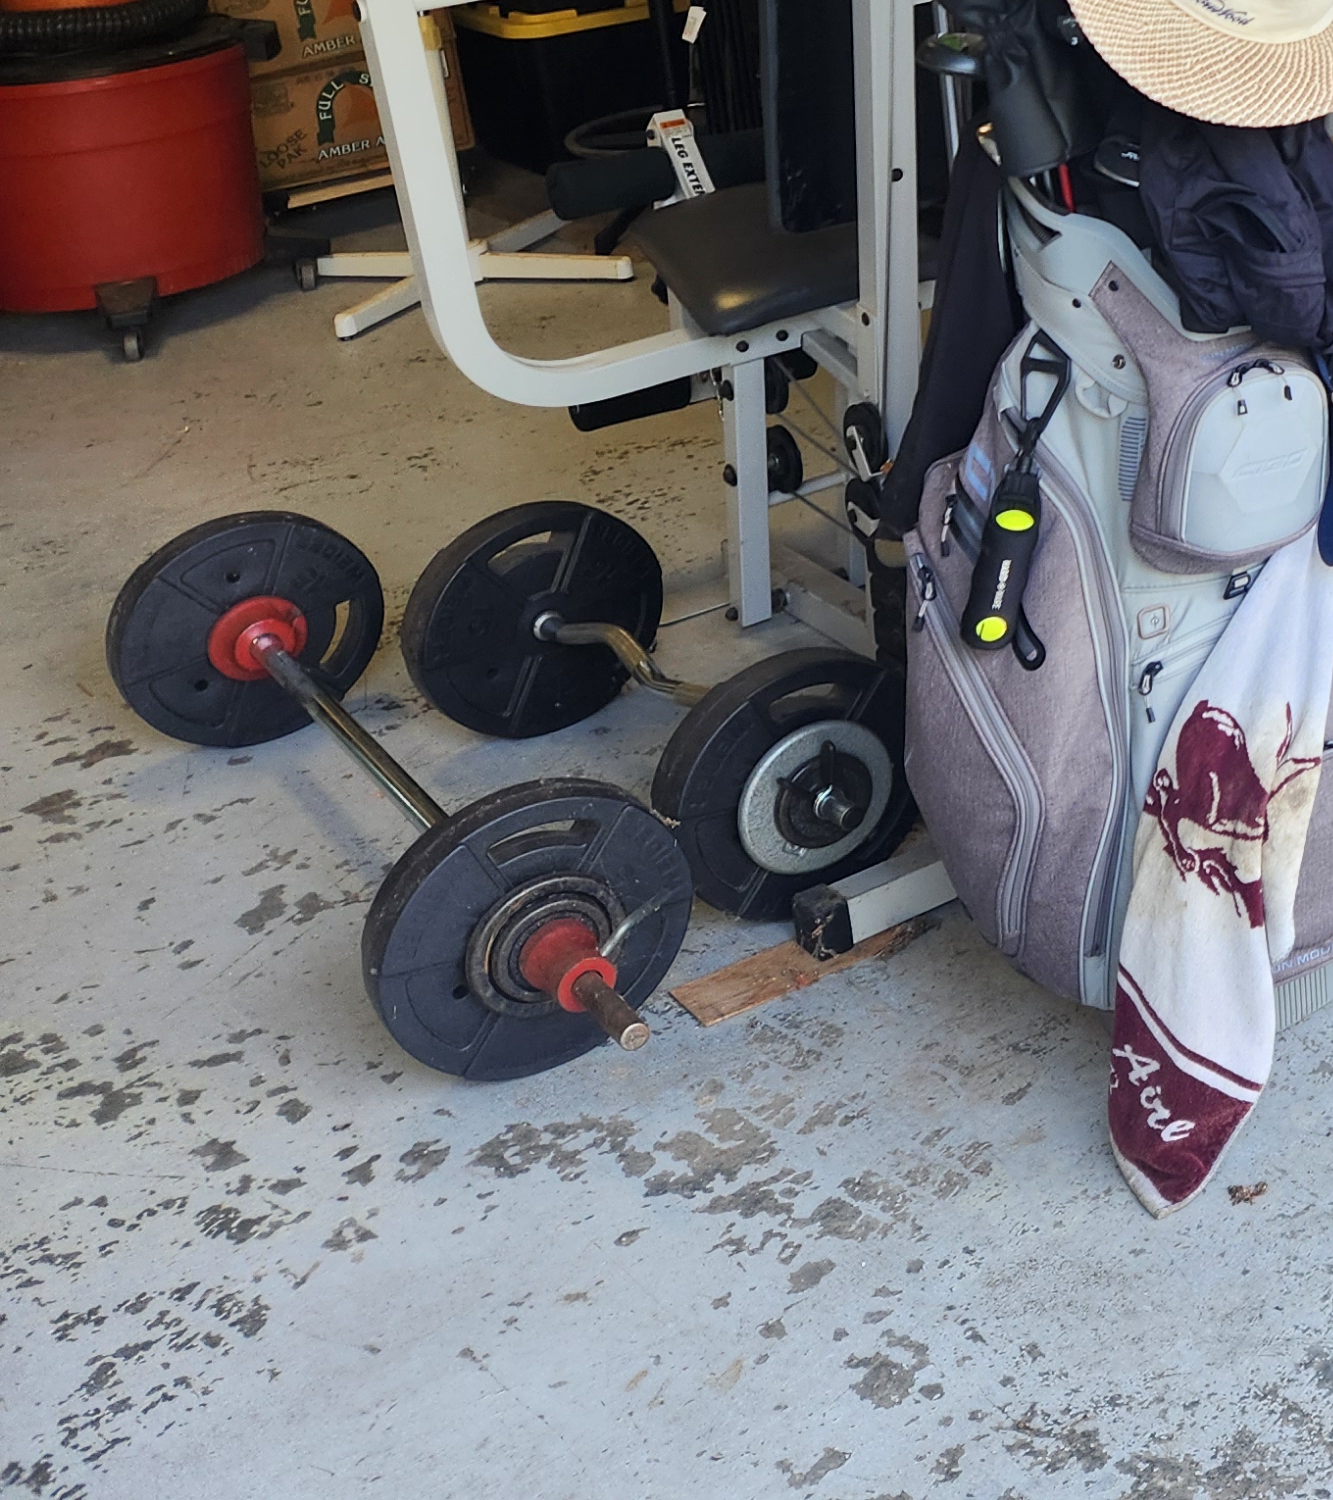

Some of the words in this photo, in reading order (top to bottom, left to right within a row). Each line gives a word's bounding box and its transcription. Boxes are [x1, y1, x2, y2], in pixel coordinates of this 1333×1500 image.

[302, 34, 356, 59] AMBER
[319, 80, 344, 121] FULL
[260, 128, 309, 170] LOOSE
[318, 140, 371, 161] AMBER
[671, 137, 689, 159] LEG
